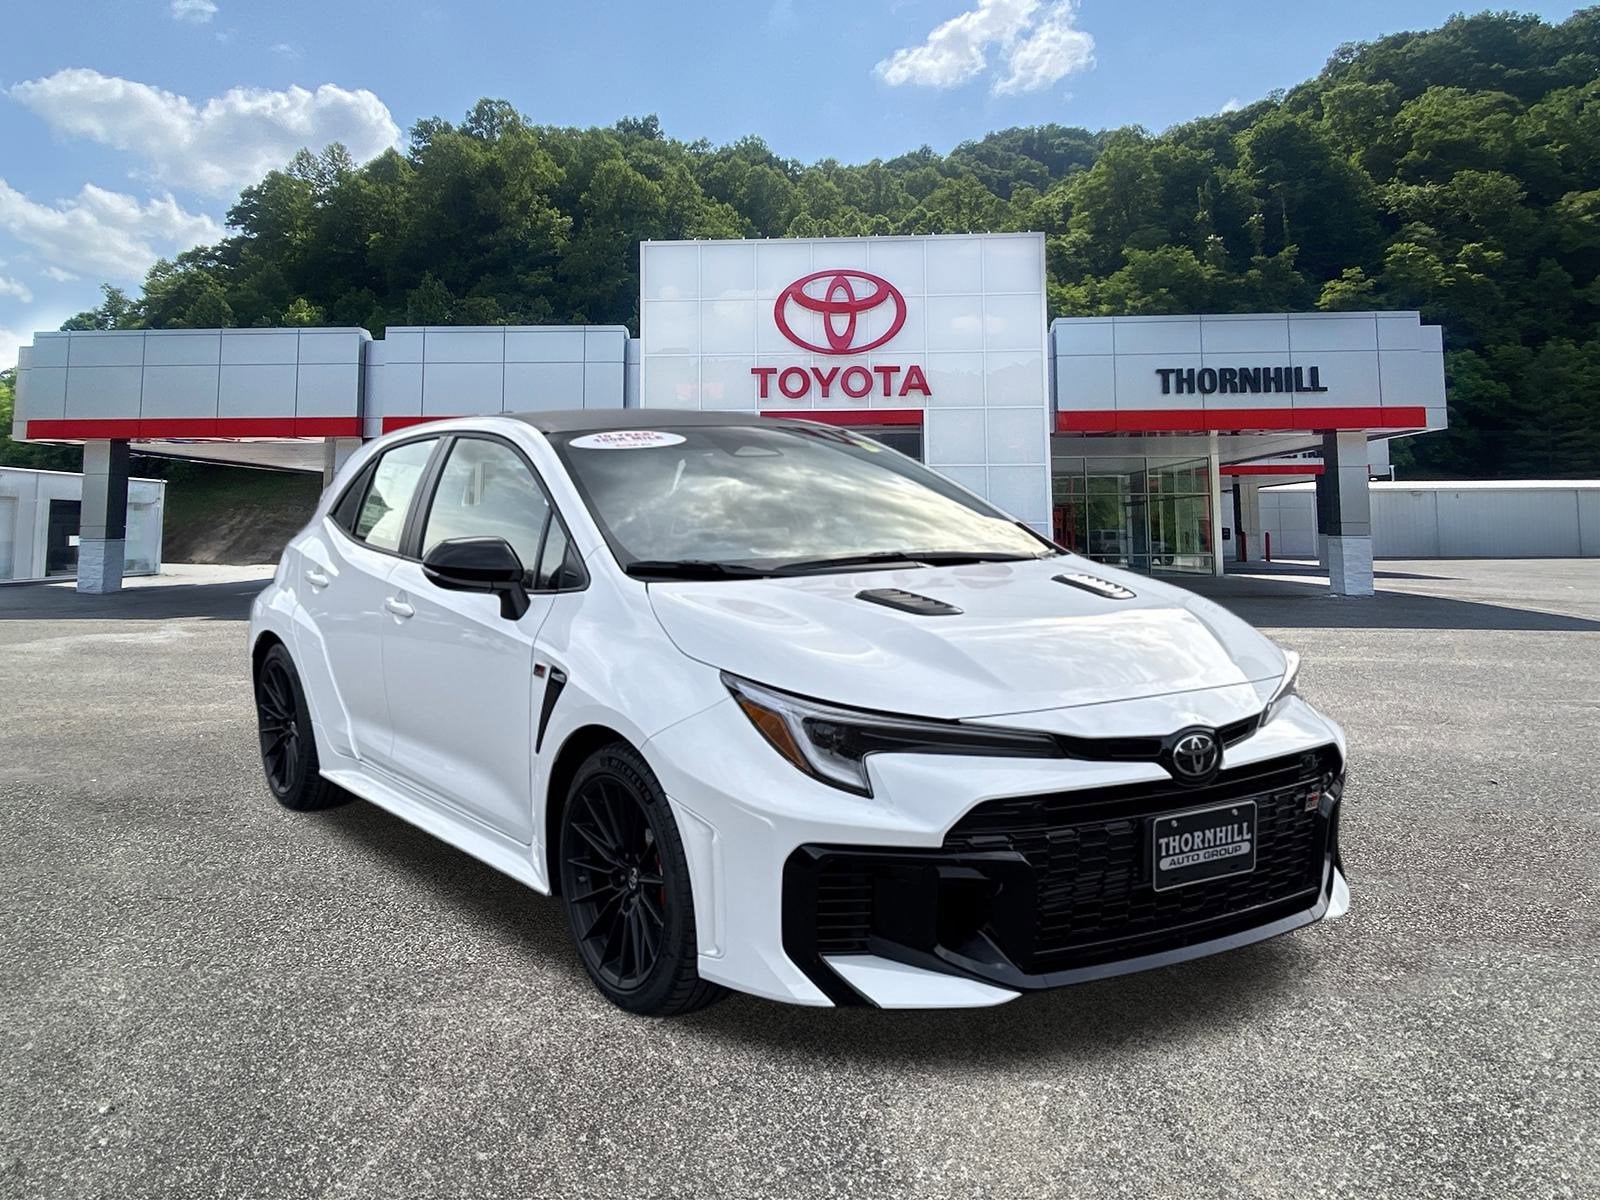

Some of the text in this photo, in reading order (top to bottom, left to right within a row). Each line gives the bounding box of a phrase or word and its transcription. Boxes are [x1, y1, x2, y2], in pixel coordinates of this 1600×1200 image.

[751, 365, 932, 399] TOYOTA
[1155, 366, 1328, 394] THORNHILL
[1158, 822, 1251, 856] THORNHILL
[1168, 845, 1242, 867] AUTO GROUP
